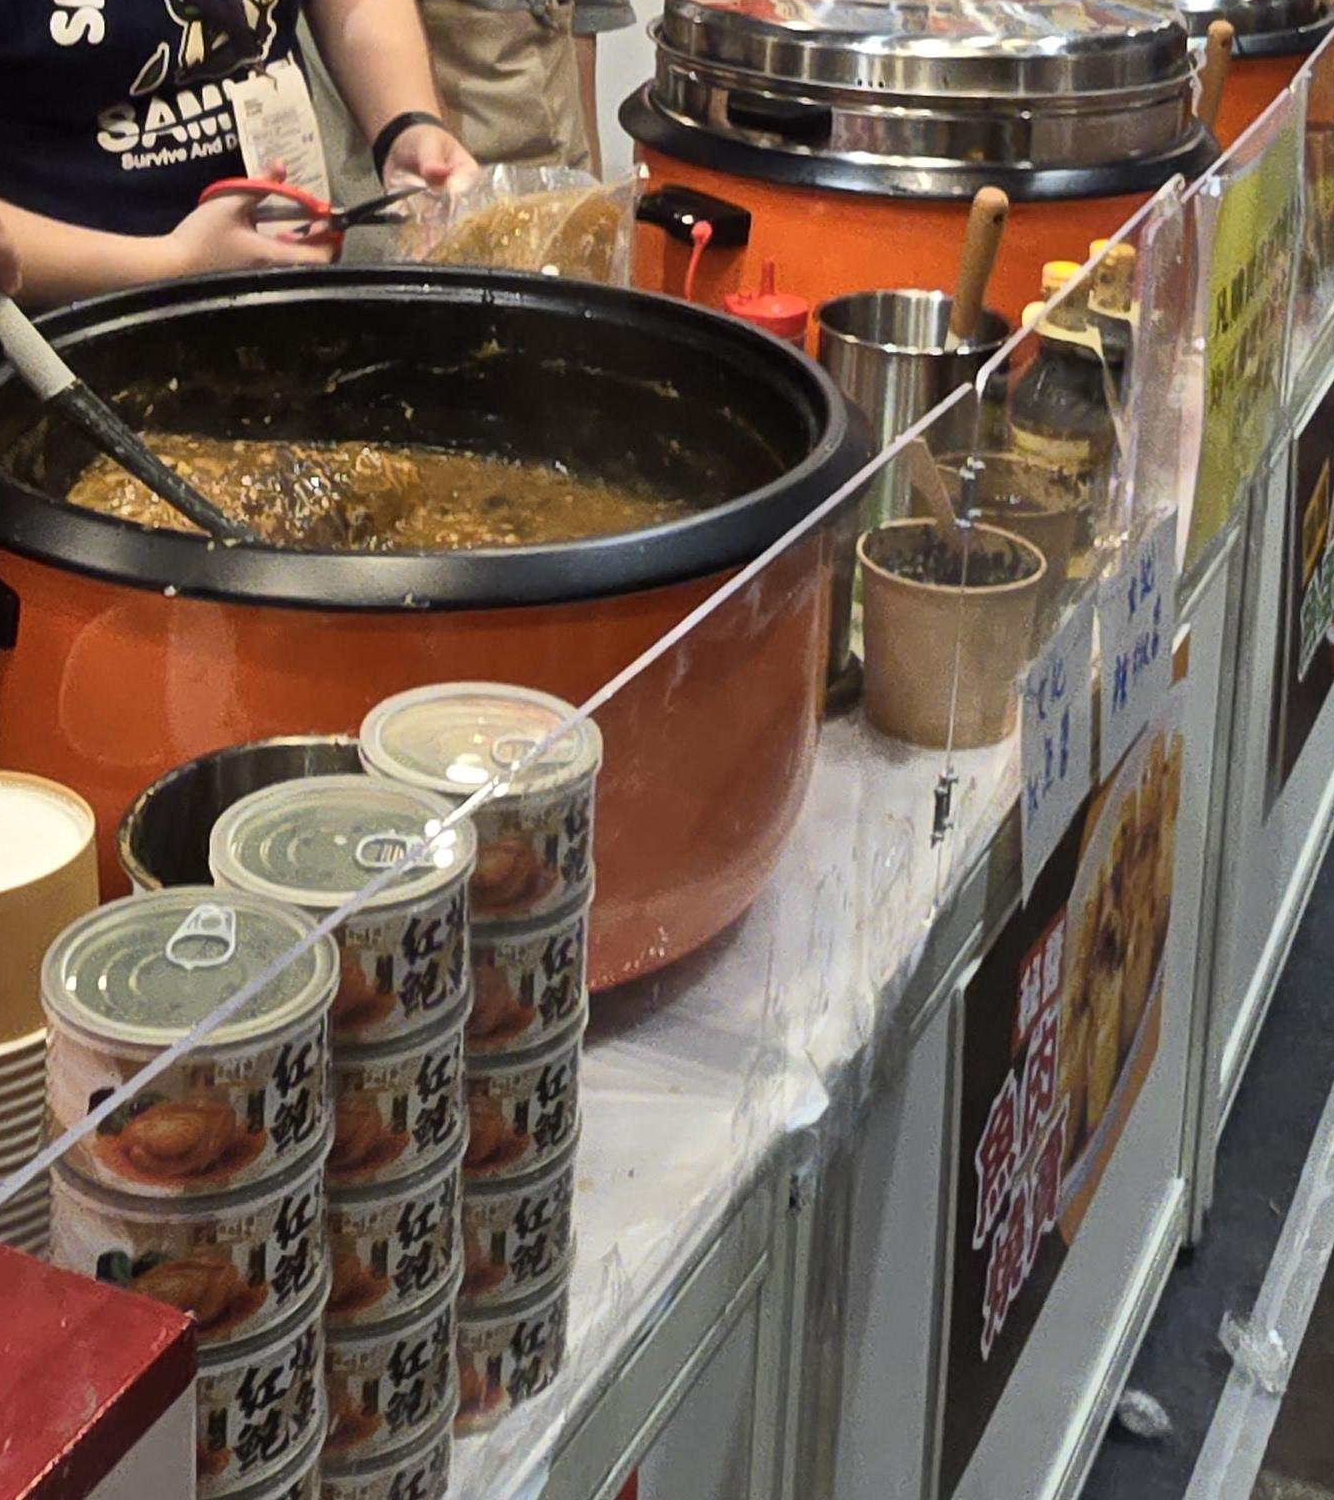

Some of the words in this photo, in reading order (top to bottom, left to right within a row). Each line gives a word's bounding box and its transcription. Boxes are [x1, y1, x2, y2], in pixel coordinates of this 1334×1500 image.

[97, 78, 239, 153] SAM
[121, 147, 188, 171] Survive
[191, 135, 223, 160] And
